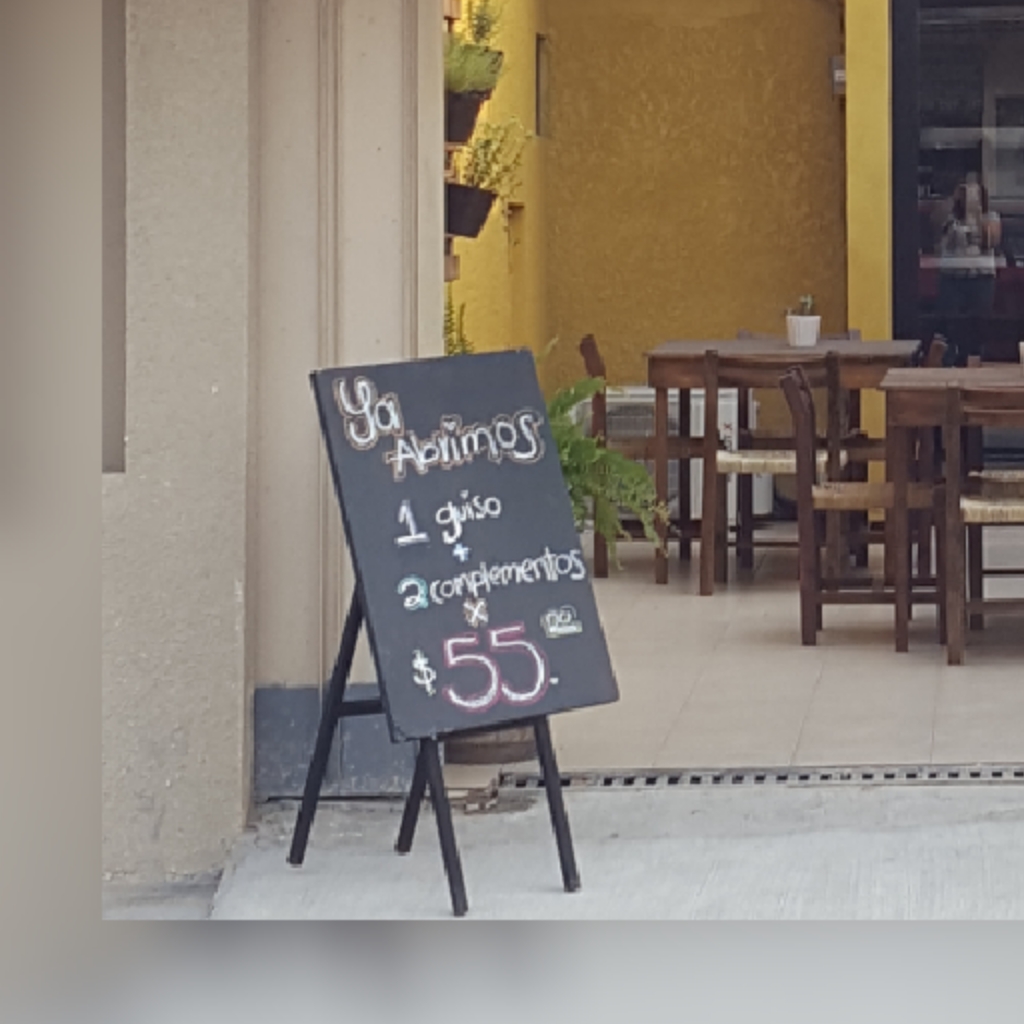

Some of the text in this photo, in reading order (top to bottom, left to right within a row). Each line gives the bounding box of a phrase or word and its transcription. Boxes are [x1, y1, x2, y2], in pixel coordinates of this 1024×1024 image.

[335, 377, 403, 449] Ya
[384, 409, 544, 480] Abrimos
[395, 489, 502, 546] 1 guiso
